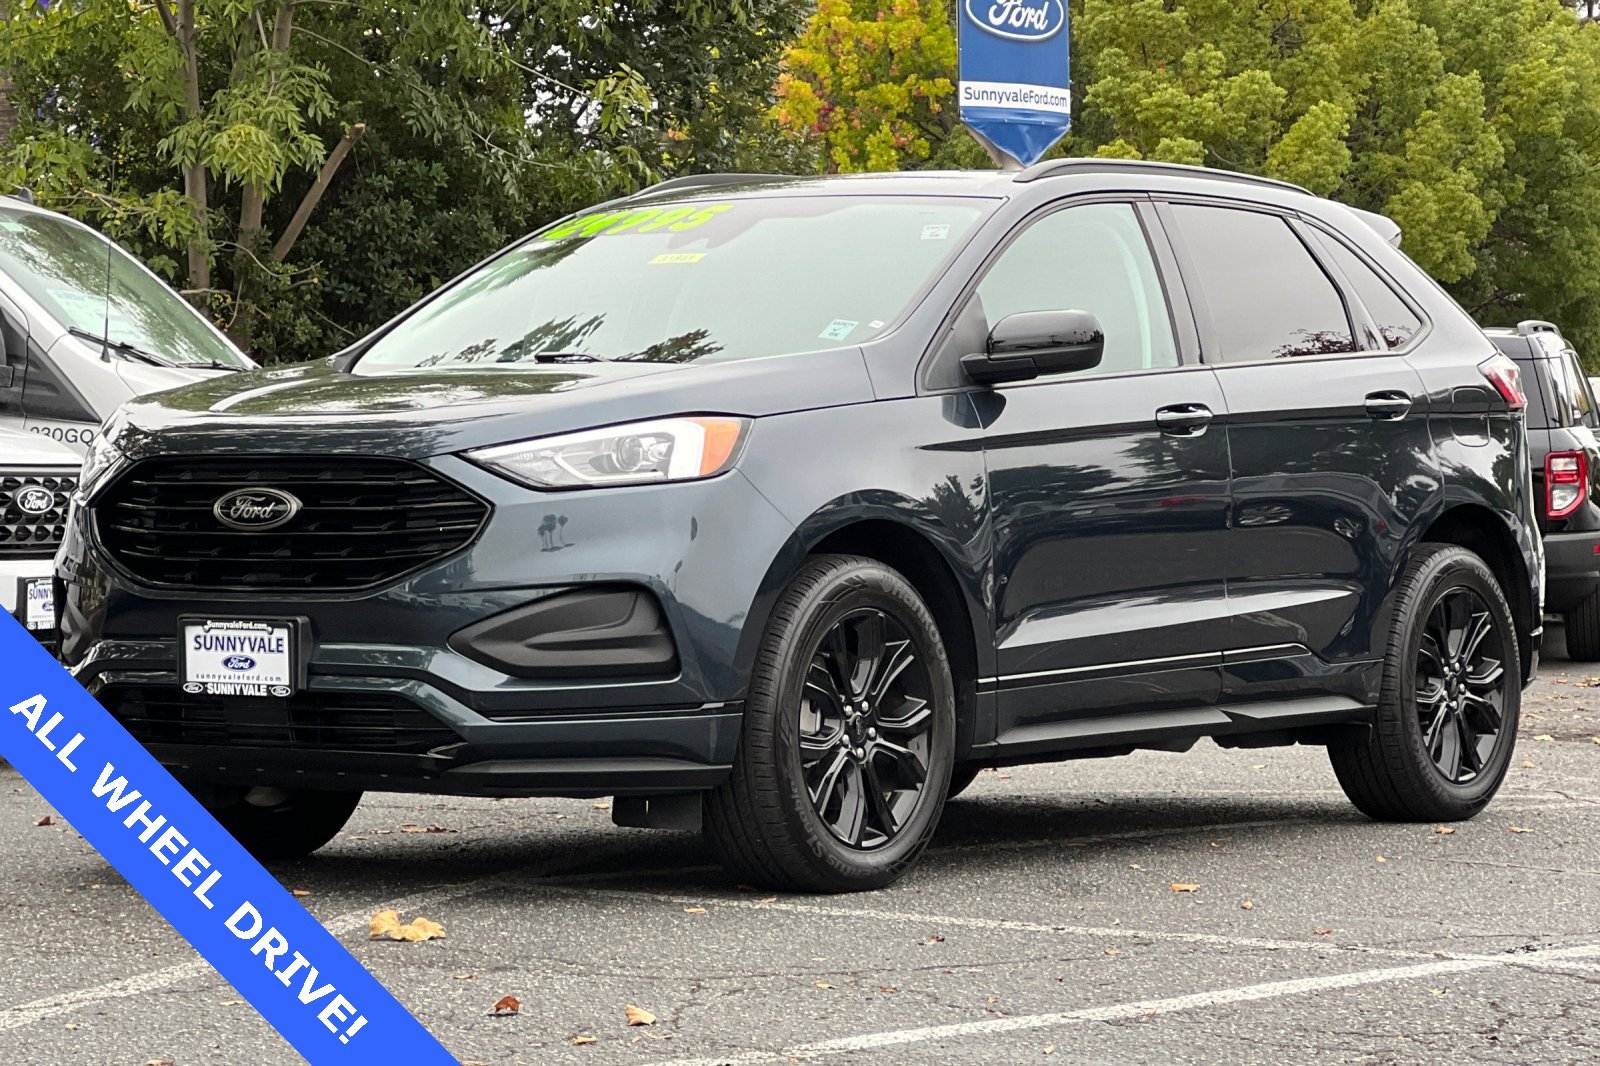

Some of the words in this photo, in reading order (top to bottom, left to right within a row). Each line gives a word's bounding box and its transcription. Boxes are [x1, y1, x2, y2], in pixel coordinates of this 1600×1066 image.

[988, 0, 1049, 30] Ford
[964, 86, 1068, 107] SunnyvaleFord.com
[24, 491, 48, 509] Ford
[230, 495, 276, 518] Ford
[193, 634, 285, 654] SUNNYVALE
[227, 655, 252, 669] Ford
[195, 673, 282, 683] sunnyvaleford.com
[206, 682, 268, 697] SUNNYVALE
